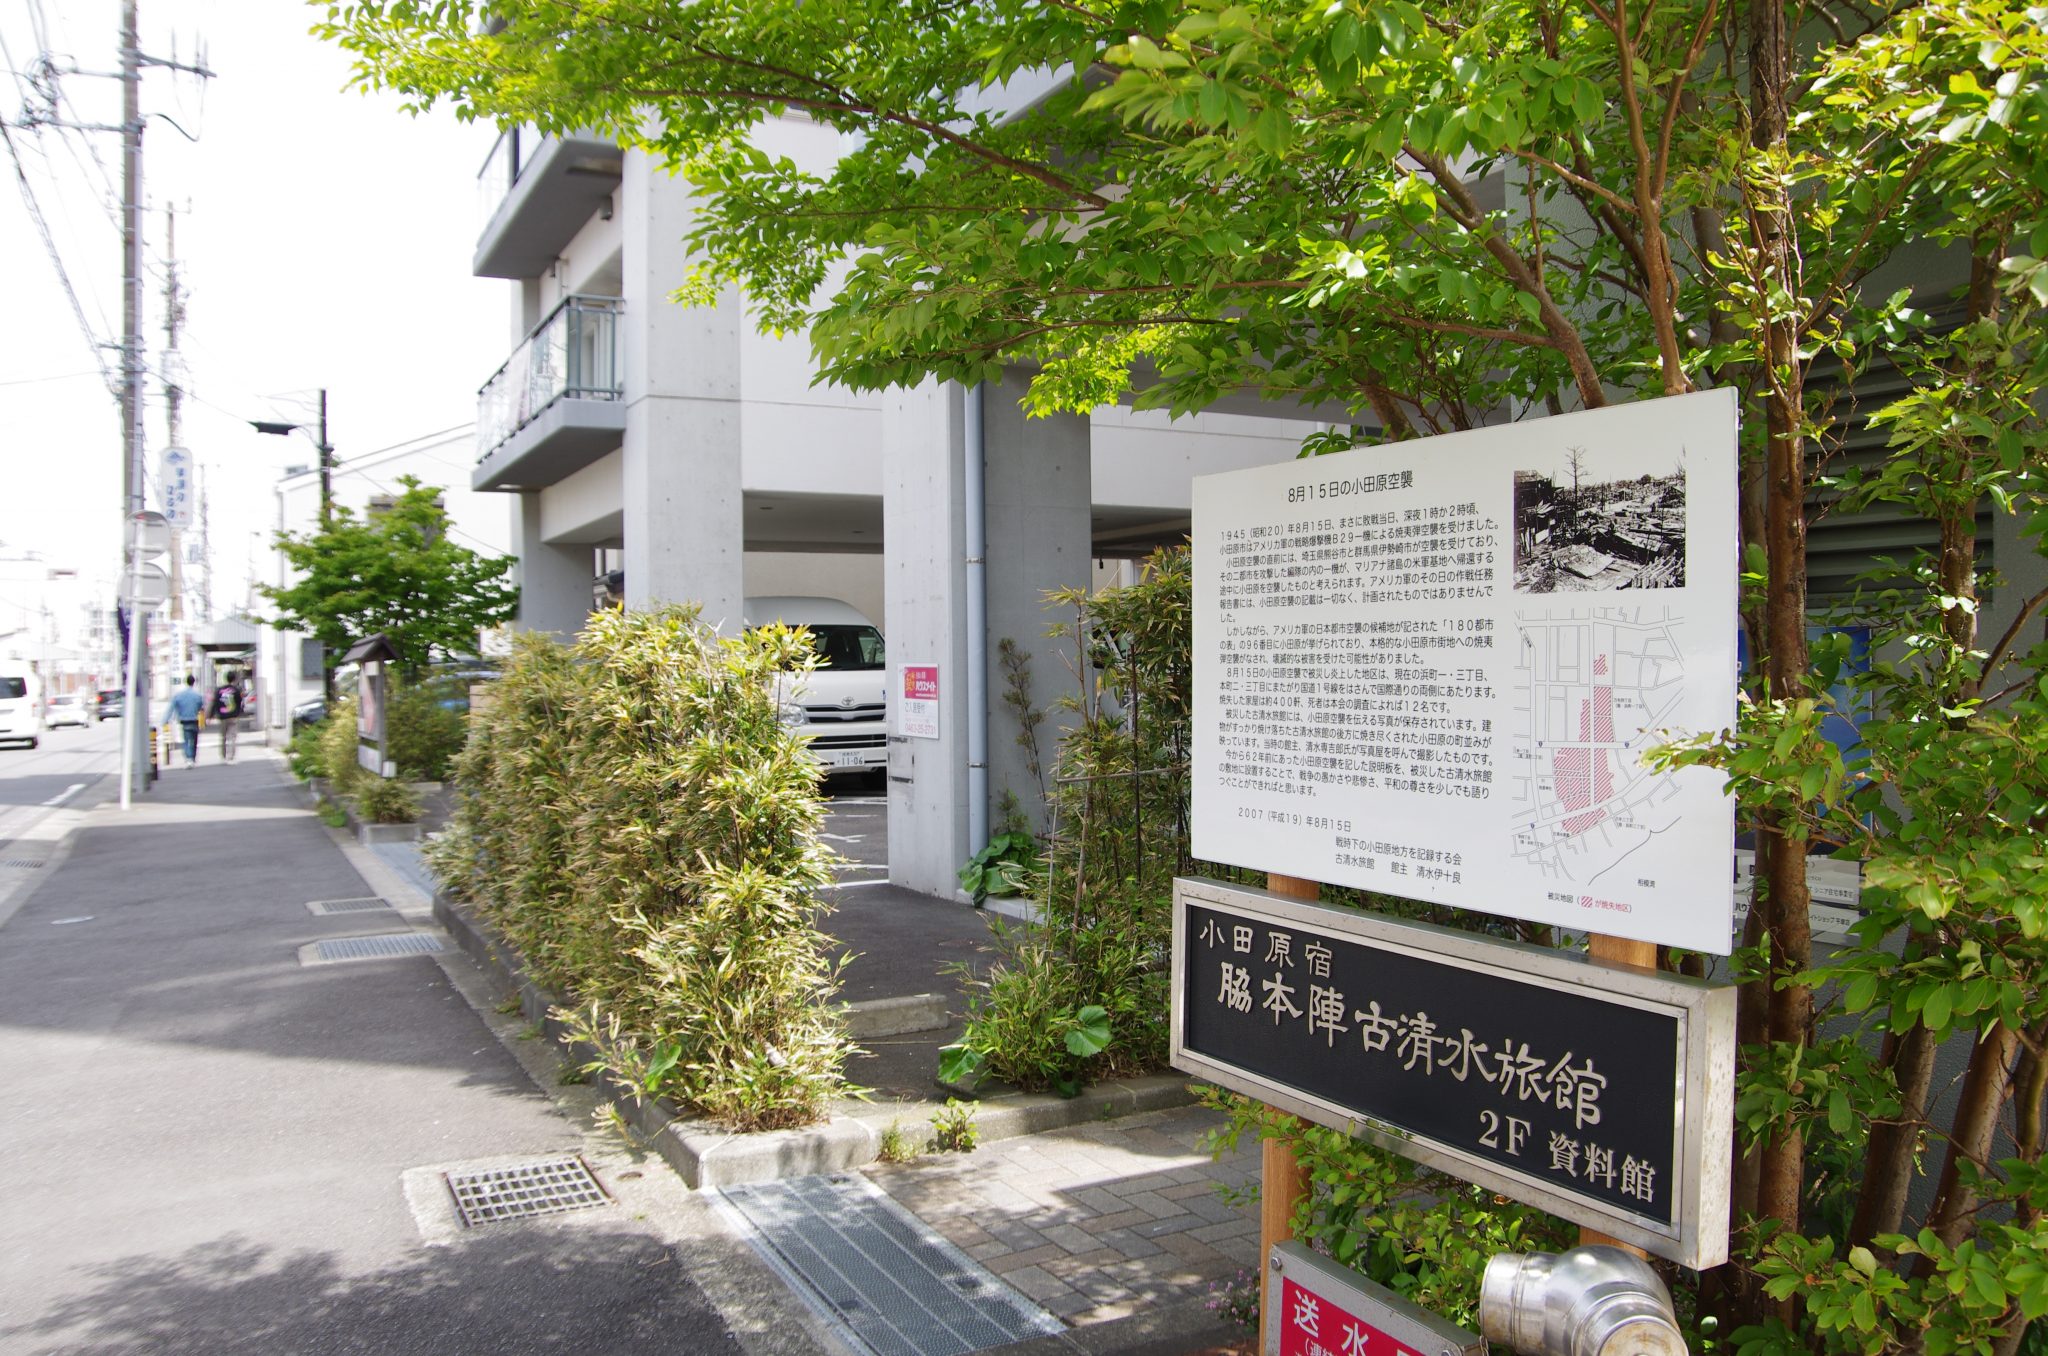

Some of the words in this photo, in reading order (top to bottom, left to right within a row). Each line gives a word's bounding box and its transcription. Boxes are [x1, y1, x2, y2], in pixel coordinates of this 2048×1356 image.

[1288, 471, 1413, 503] 8月15日の小田原空襲
[1220, 613, 1236, 623] した。
[1220, 653, 1425, 665] 弾空襲がなされ、壊滅的な被害を受けた可能性がありました。
[1219, 776, 1317, 797] つぐことができればと思います。
[1335, 836, 1462, 866] 戦時下の小田原地方を記録する会
[1335, 853, 1375, 870] 古清水旅館
[1390, 861, 1408, 875] 館主
[1199, 917, 1334, 980] 小田原宿
[1478, 1109, 1534, 1157] 2F
[1548, 1130, 1657, 1204] 資料館
